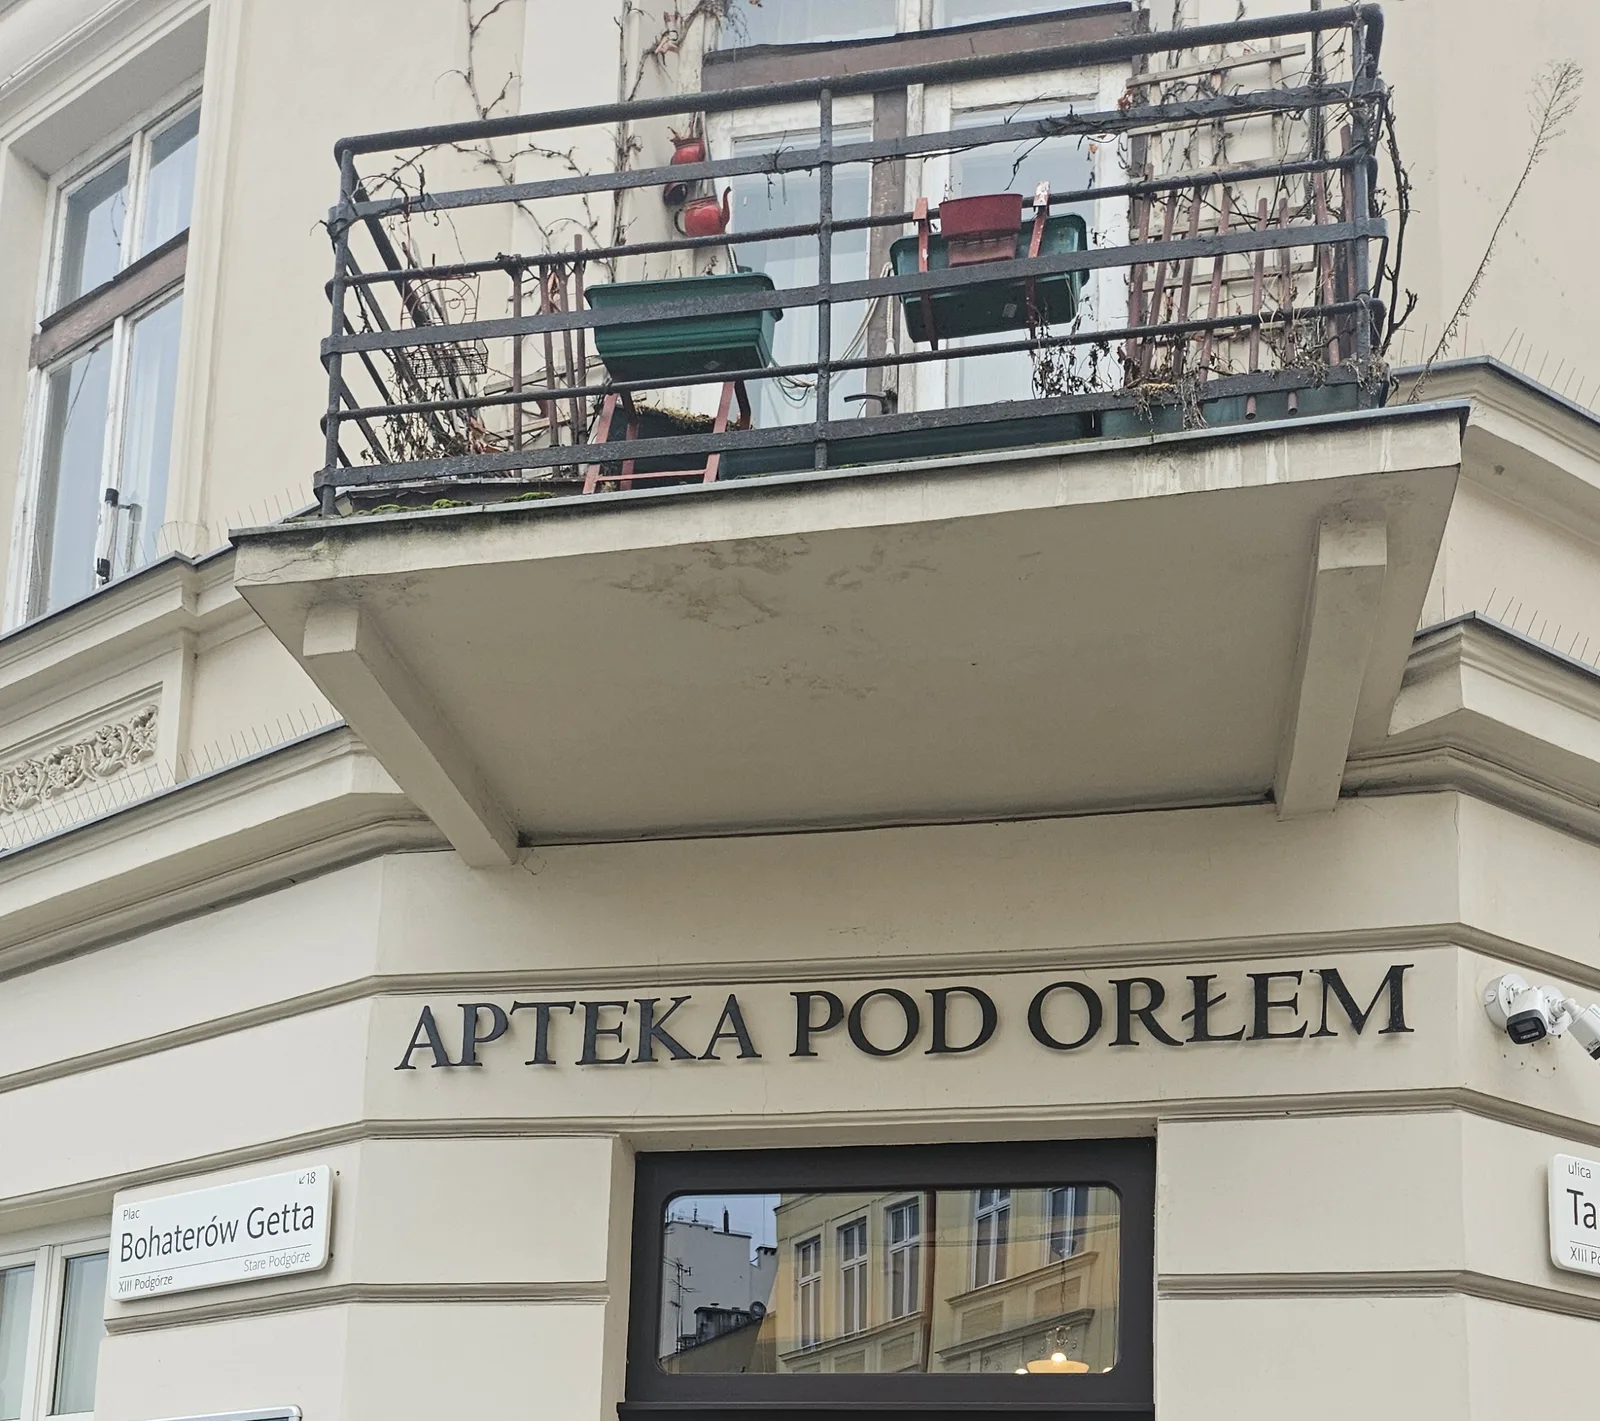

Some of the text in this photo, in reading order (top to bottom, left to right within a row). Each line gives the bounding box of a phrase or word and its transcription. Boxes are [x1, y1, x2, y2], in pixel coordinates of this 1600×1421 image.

[394, 963, 1417, 1071] APTEKA POD ORŁEM
[306, 1171, 316, 1185] 18
[1568, 1161, 1591, 1179] ulica
[123, 1209, 140, 1221] Plac
[1566, 1188, 1597, 1230] Ta
[120, 1202, 314, 1263] Bohaterów Getta
[244, 1251, 310, 1272] Stare Podgórze
[1570, 1246, 1587, 1262] XIII
[118, 1274, 173, 1293] XIII Podgórze
